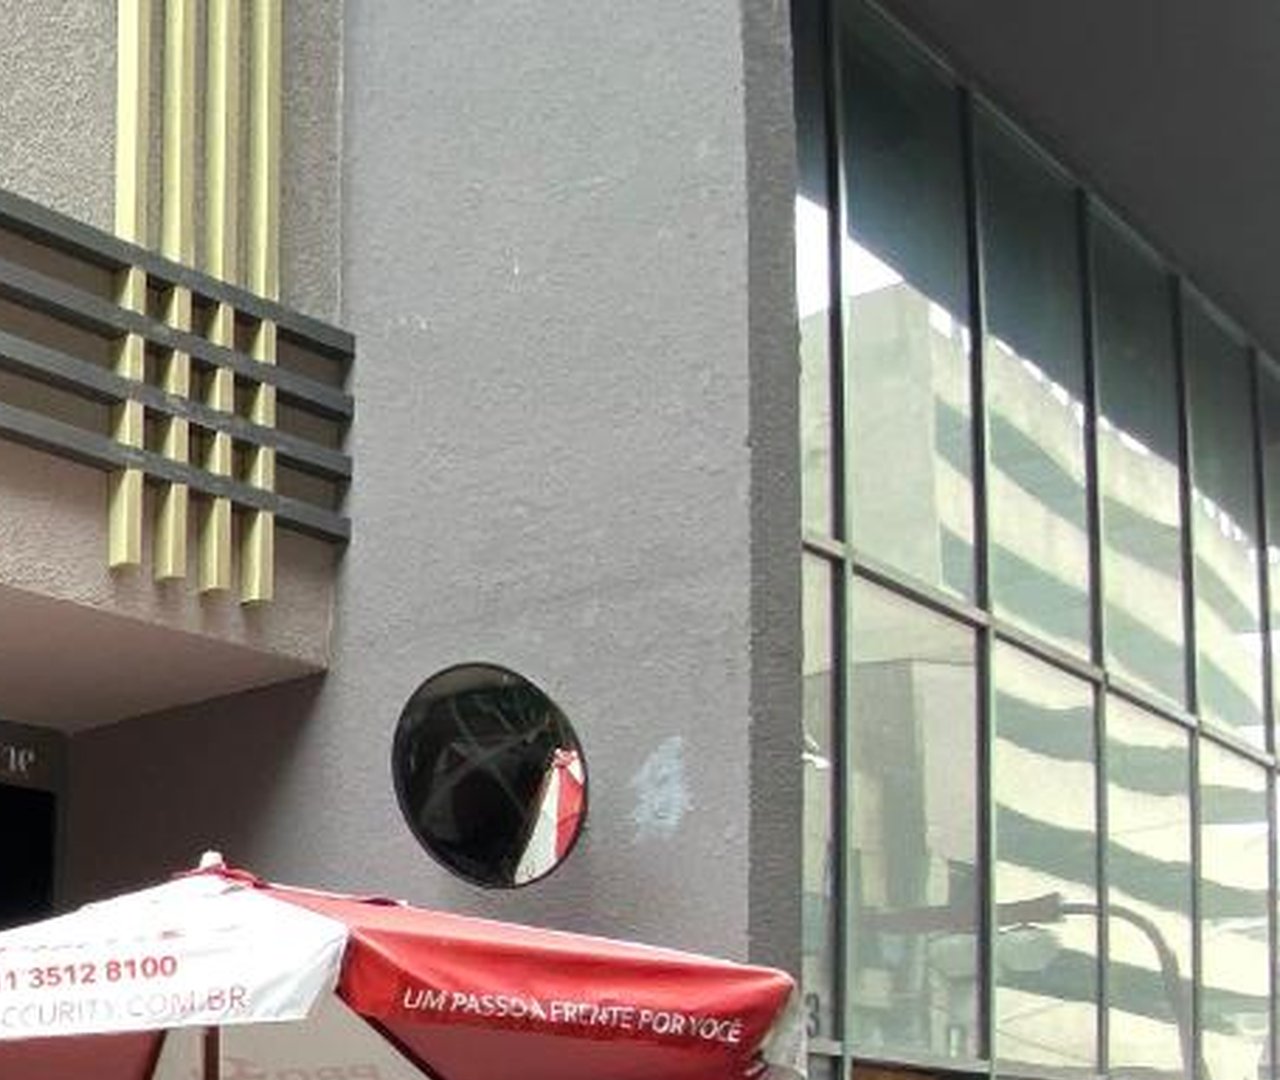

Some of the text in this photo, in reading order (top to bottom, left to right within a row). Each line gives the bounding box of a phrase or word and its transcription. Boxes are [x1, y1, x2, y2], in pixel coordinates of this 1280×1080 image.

[30, 964, 96, 988] 3512
[106, 955, 178, 982] 8100
[403, 987, 446, 1011] UM
[550, 1000, 633, 1029] FRENTE
[638, 1008, 685, 1036] POR
